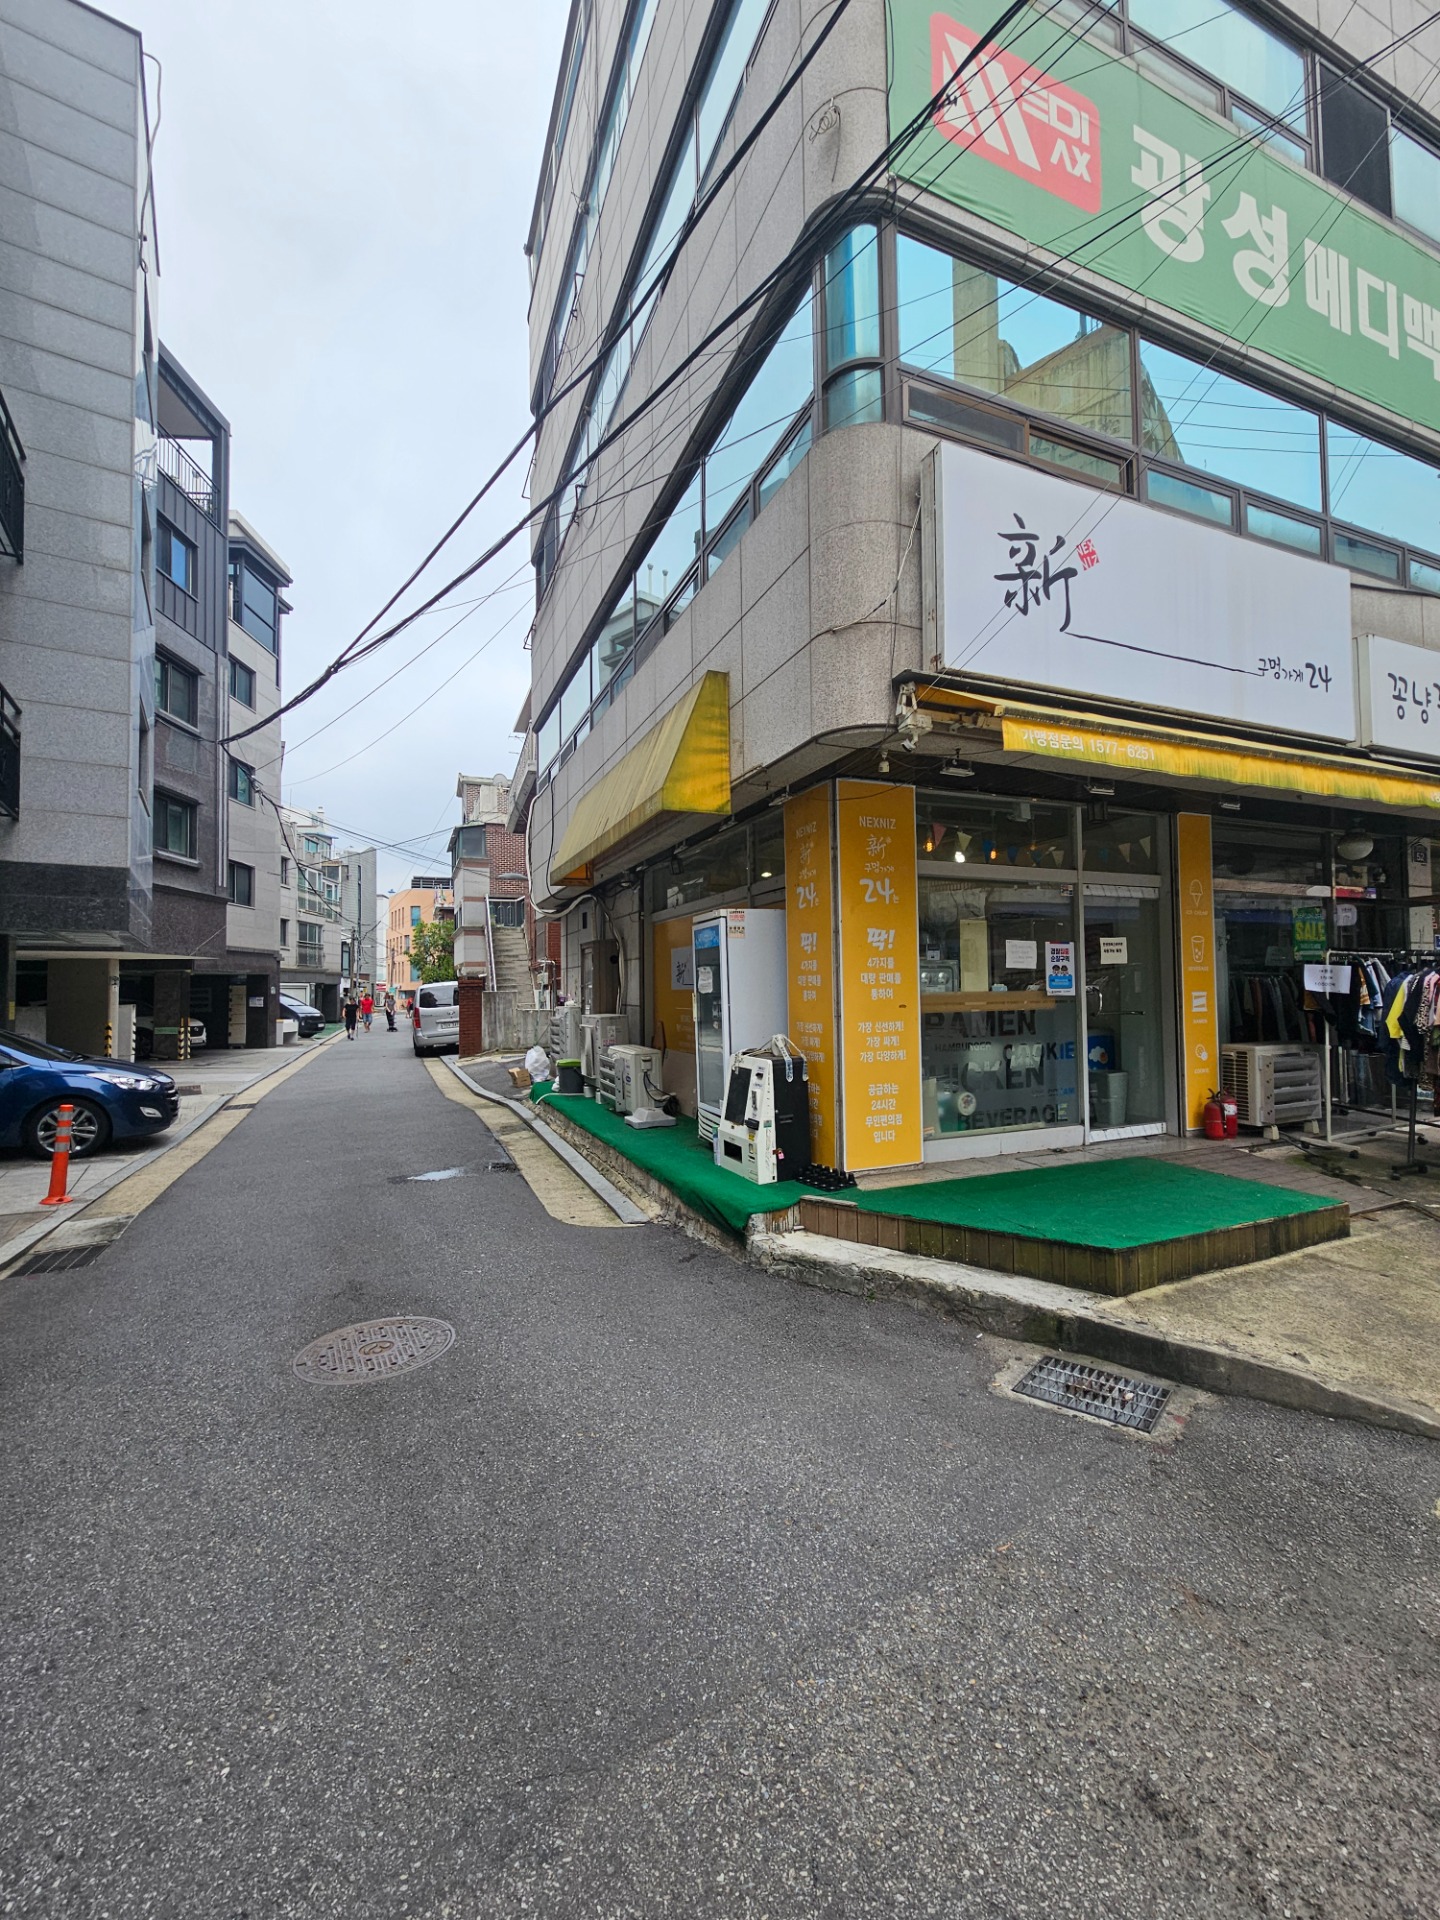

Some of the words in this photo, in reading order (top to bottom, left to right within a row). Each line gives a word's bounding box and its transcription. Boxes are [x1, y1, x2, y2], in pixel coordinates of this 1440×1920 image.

[994, 513, 1078, 633] 新
[1089, 738, 1155, 761] 1577-6251
[859, 816, 897, 830] NEXNIZ
[1416, 852, 1425, 862] 52
[1295, 921, 1325, 940] SALE
[867, 927, 896, 951] 딱!
[858, 1021, 872, 1034] 가장
[875, 1021, 904, 1033] 신선하게!
[866, 1036, 880, 1048] 가장
[860, 1051, 873, 1063] 가장
[876, 1050, 906, 1062] 다양하게!
[1003, 1041, 1076, 1063] COOKIE
[868, 1083, 899, 1096] 공급하는
[871, 1098, 896, 1111] 24시간
[873, 1130, 895, 1143] 입니다
